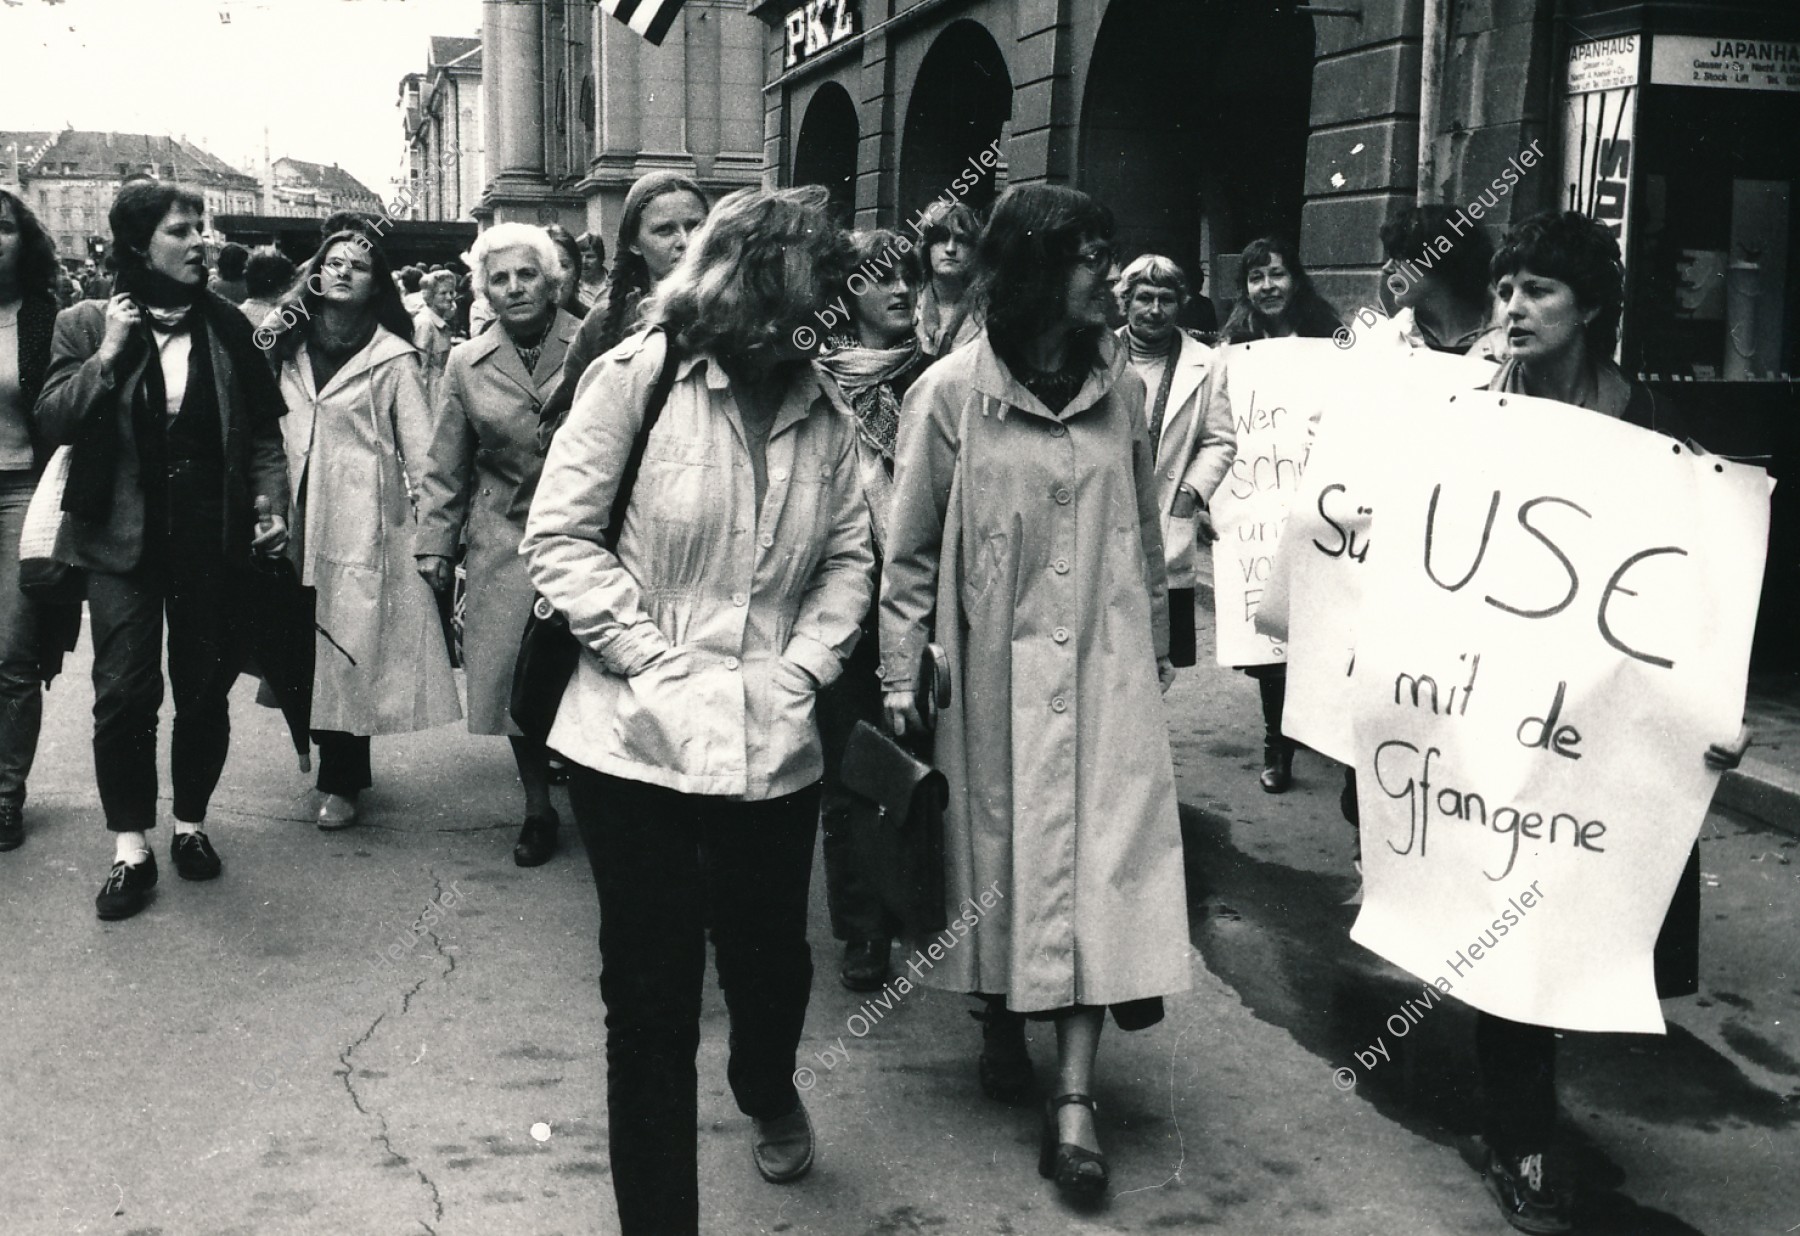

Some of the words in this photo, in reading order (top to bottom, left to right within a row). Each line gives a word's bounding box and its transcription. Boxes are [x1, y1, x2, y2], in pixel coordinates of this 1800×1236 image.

[785, 0, 853, 68] PKZ
[1569, 36, 1634, 62] APANHAUS
[1424, 482, 1688, 670] USE
[1395, 652, 1480, 717] mit
[1516, 680, 1582, 760] de
[1373, 739, 1607, 881] Gfangene
